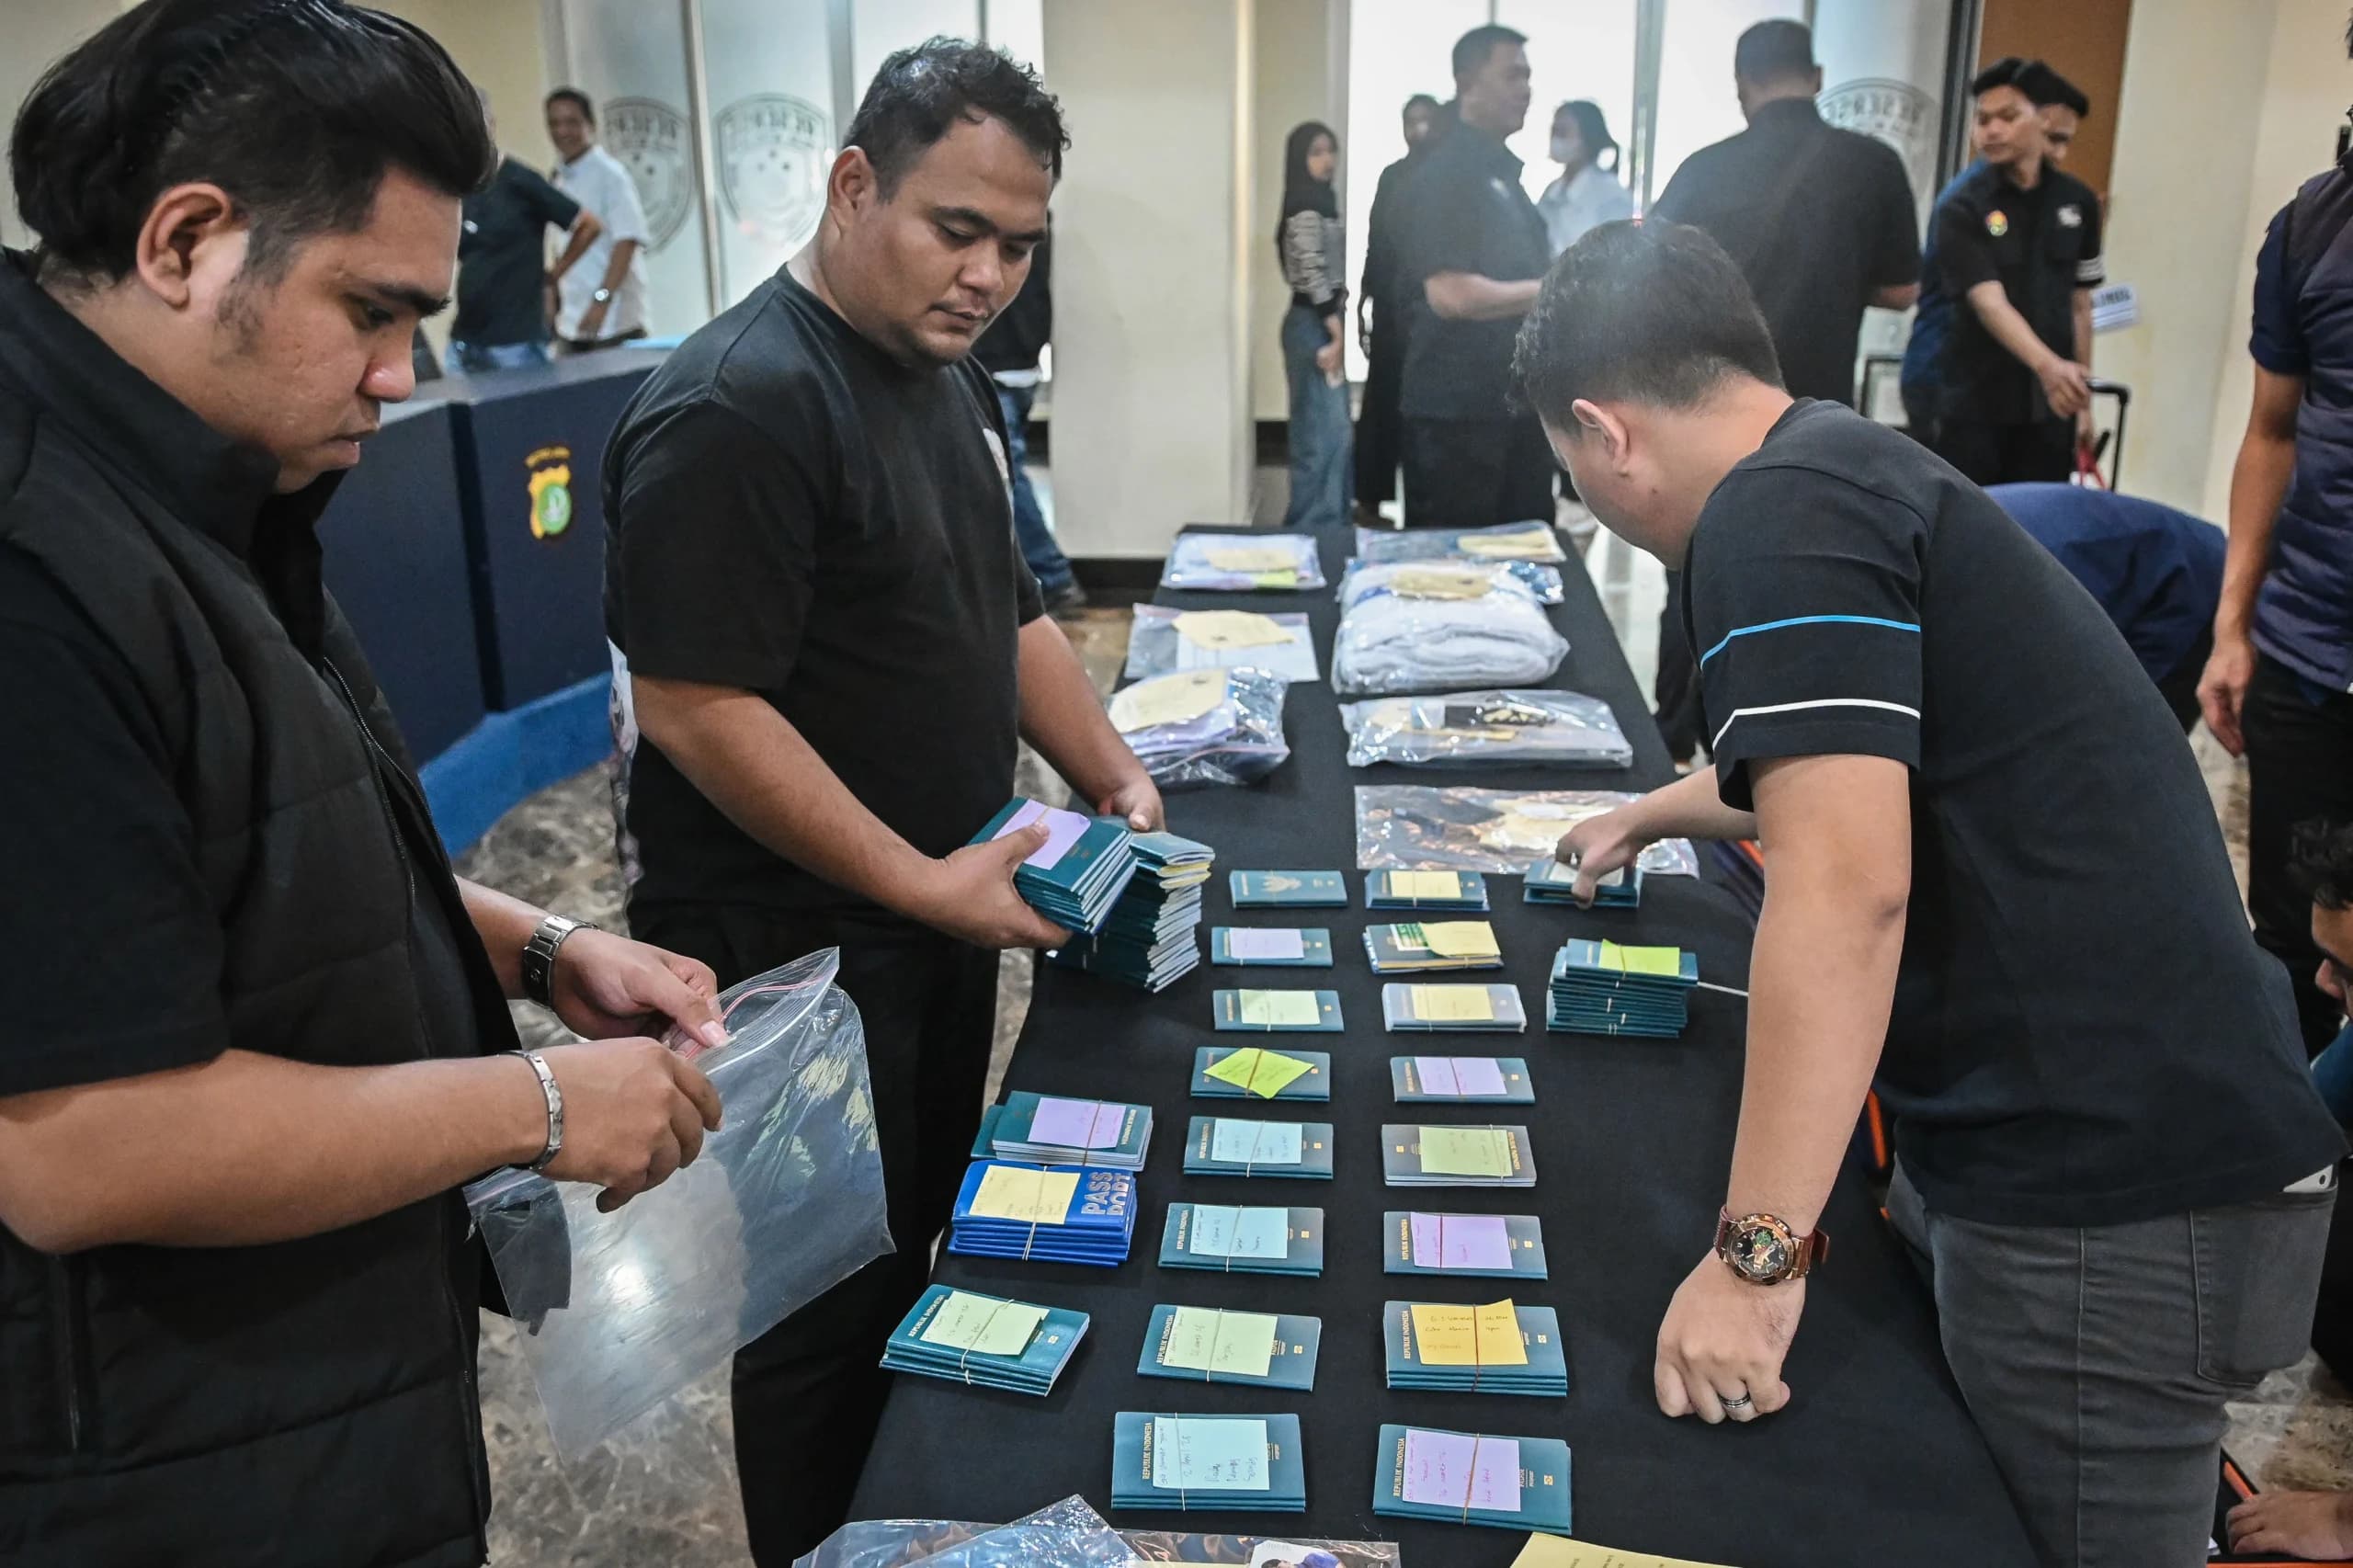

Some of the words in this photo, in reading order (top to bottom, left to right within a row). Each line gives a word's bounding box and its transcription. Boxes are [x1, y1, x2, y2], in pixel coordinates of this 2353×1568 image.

[1080, 1171, 1113, 1215] PASS
[1161, 1314, 1175, 1340] INDONESIA
[1402, 1310, 1410, 1335] INDONESIA
[1155, 1340, 1169, 1363] REPUBLIK
[1403, 1335, 1411, 1359] REPUBLIK
[1142, 1422, 1153, 1451] INDONESIA
[1142, 1452, 1151, 1480] REPUBLIK
[1394, 1437, 1405, 1469] INDONESIA
[1392, 1469, 1403, 1497] REPUBLIK
